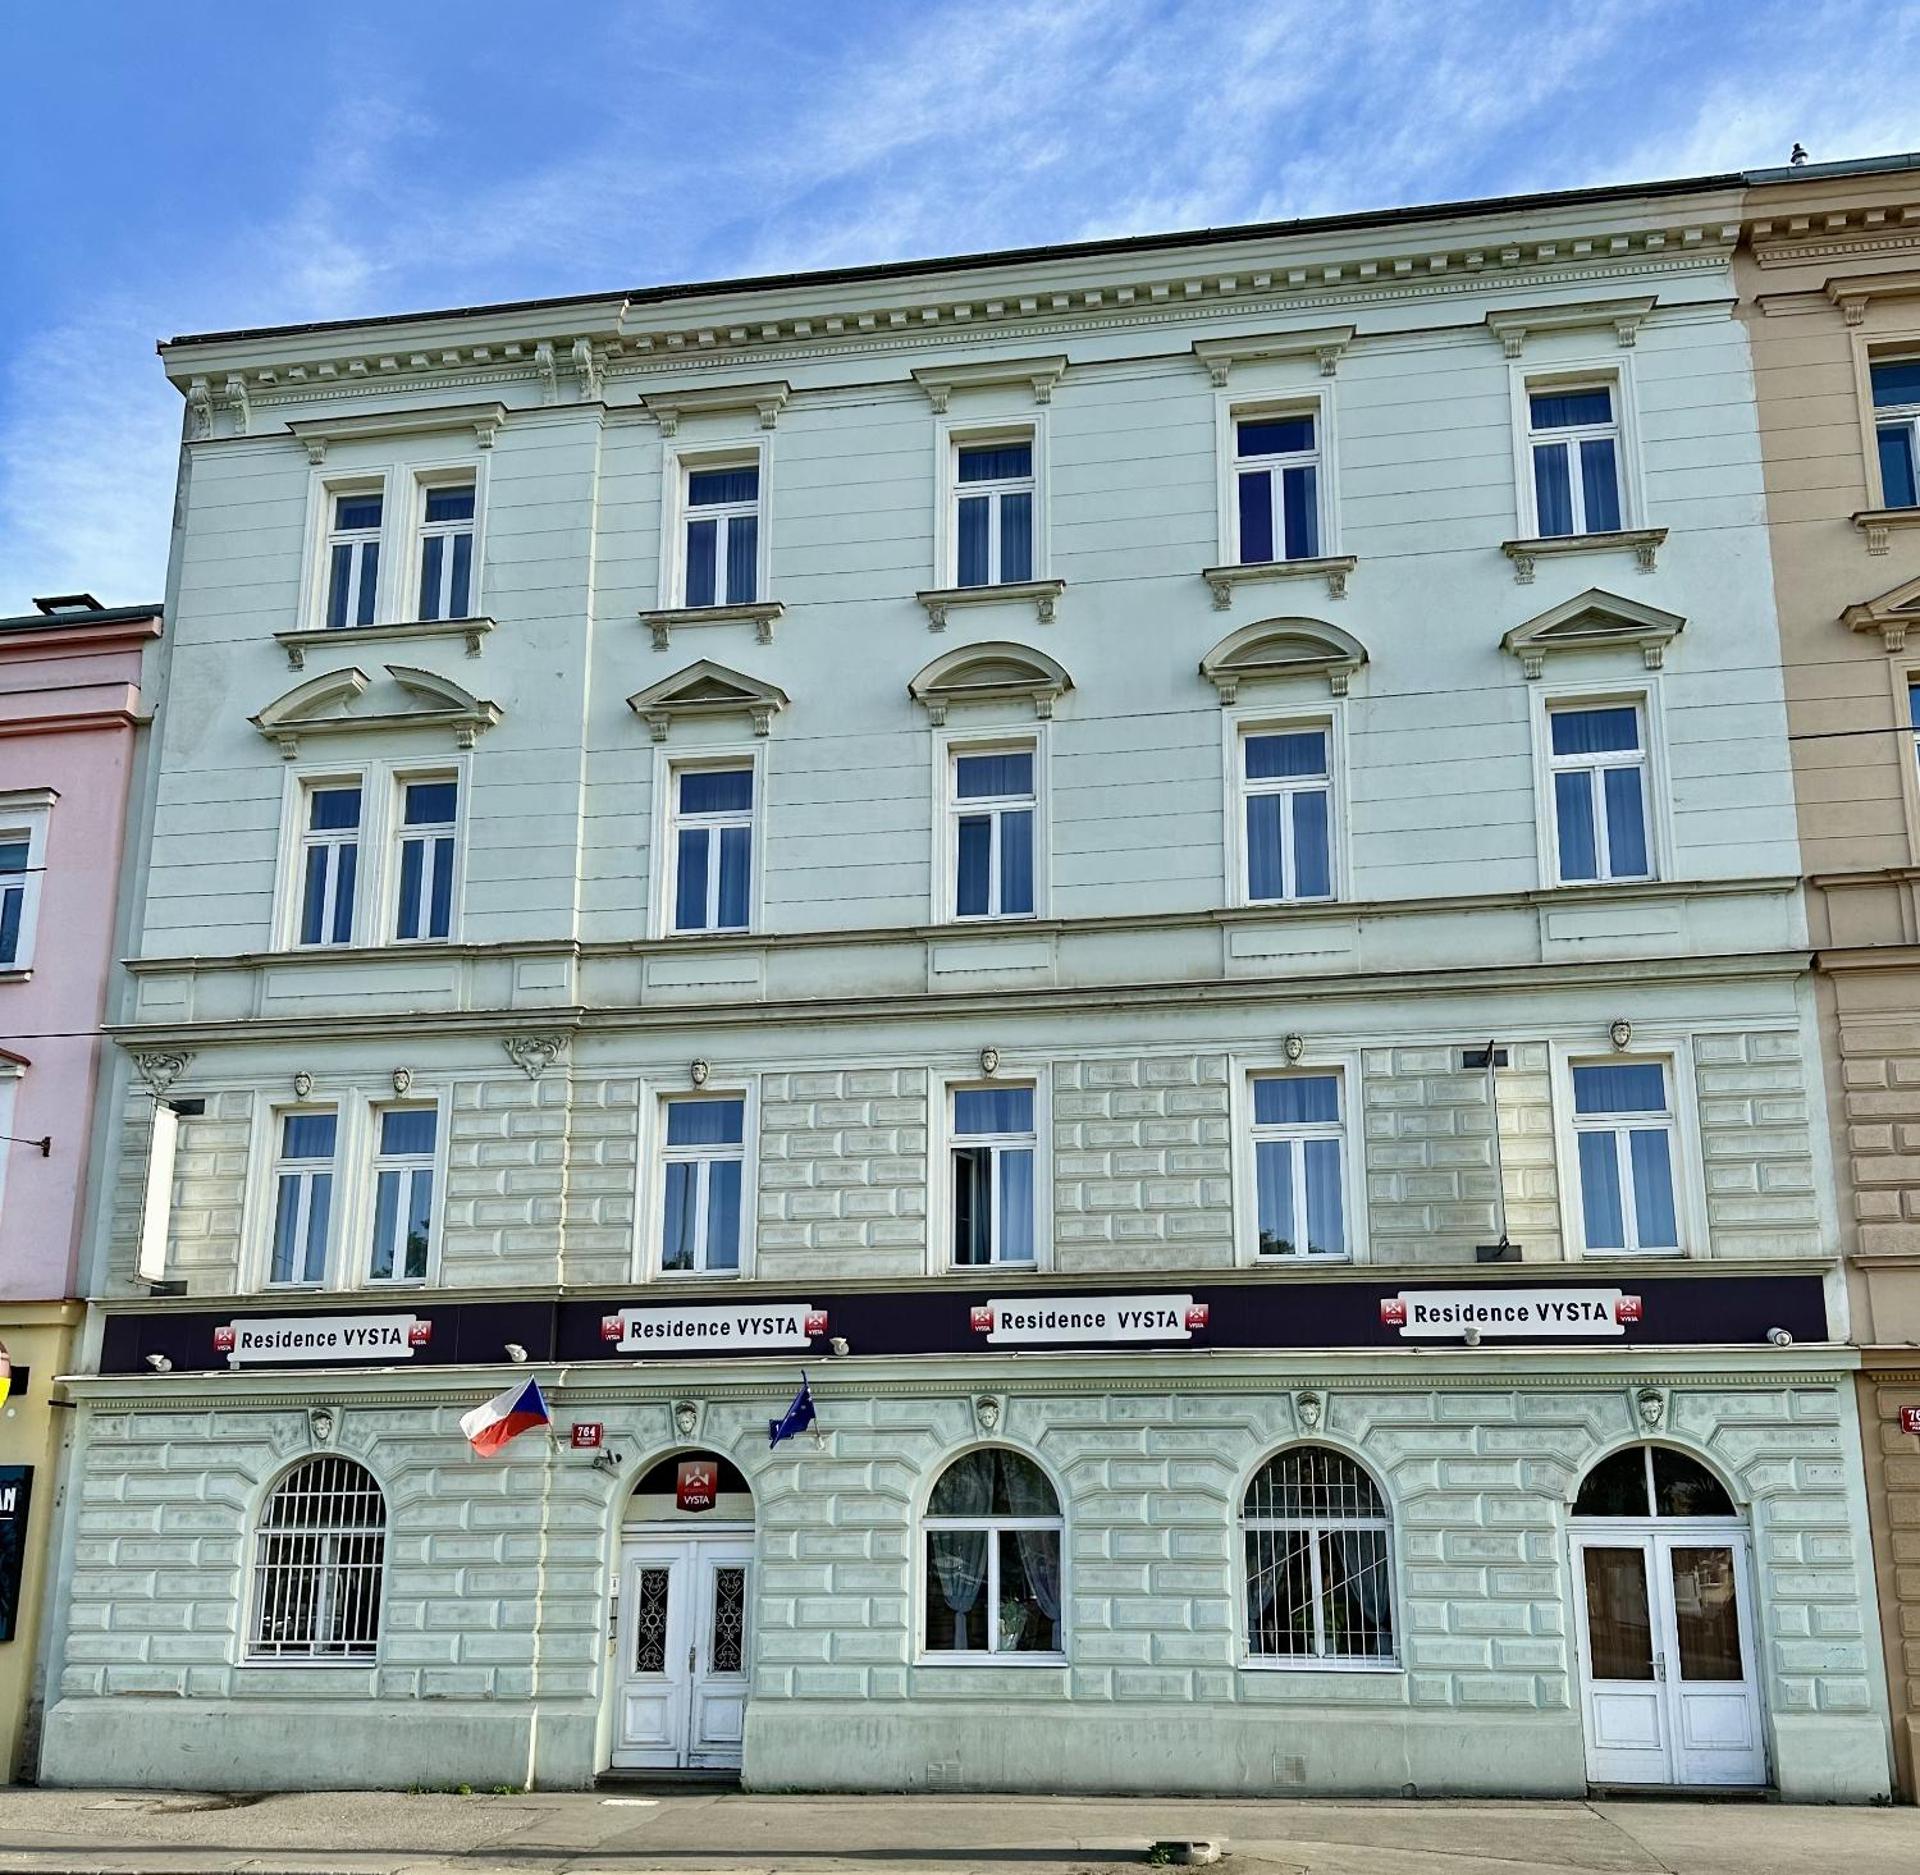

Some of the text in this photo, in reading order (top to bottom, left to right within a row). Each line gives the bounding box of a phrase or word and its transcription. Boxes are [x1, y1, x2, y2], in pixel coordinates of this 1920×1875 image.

[1001, 1310, 1179, 1329] Residence VYSTA
[1414, 1302, 1609, 1323] Residence VYSTA
[631, 1317, 798, 1338] Residence VYSTA
[241, 1328, 402, 1349] Residence VYSTA
[577, 1426, 596, 1437] 764
[683, 1495, 710, 1505] VYSTA
